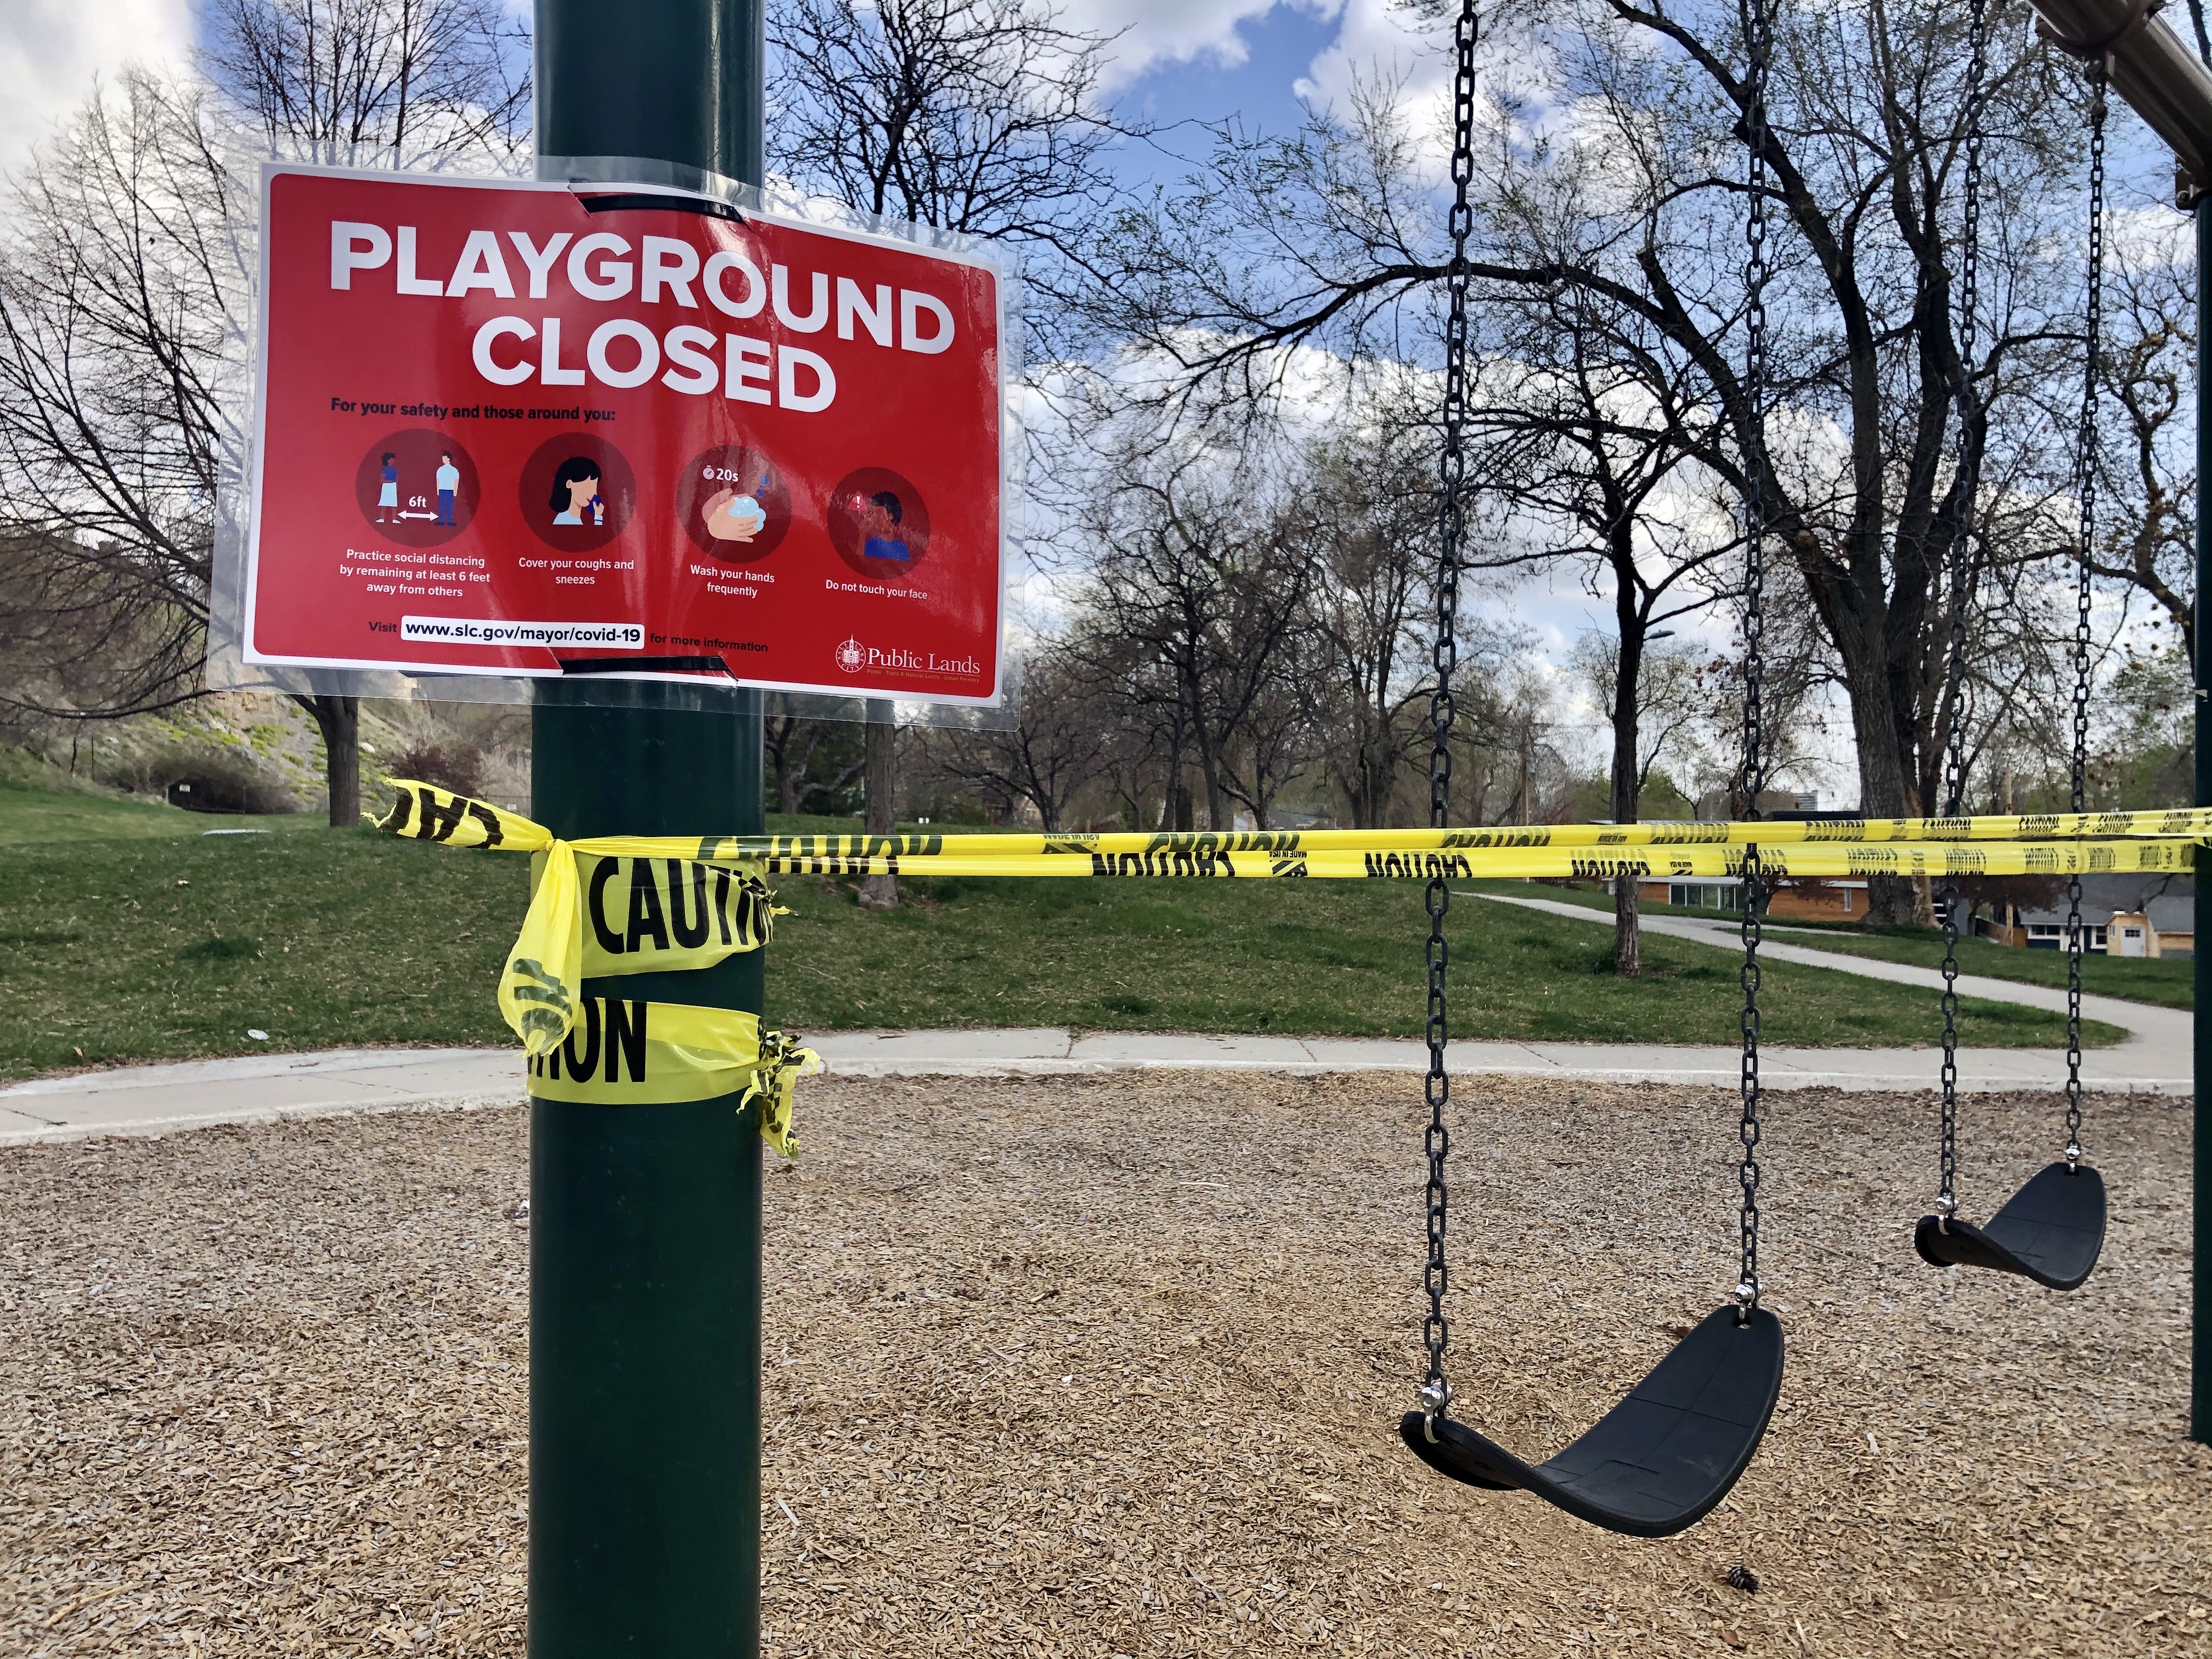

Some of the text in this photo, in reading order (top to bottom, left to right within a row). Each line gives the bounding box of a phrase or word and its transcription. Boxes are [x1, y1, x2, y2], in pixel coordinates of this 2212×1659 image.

[331, 221, 956, 354] PLAYGROUND
[472, 315, 837, 413] CLOSED
[331, 398, 615, 423] For your safety and those around you:
[716, 469, 738, 482] 20s
[409, 496, 426, 507] 6ft
[347, 549, 484, 568] Practice social distancing
[519, 557, 634, 571] Cover your coughs and
[340, 565, 490, 582] by remaining at least 6 feet
[691, 565, 774, 583] Wash your hands
[367, 584, 462, 596] away from others
[707, 582, 758, 598] frequently
[826, 580, 927, 599] Do not touch your face
[369, 622, 768, 652] Visit www.slc.gov/mayor/covid-19 for more information
[867, 647, 981, 674] Public Lands
